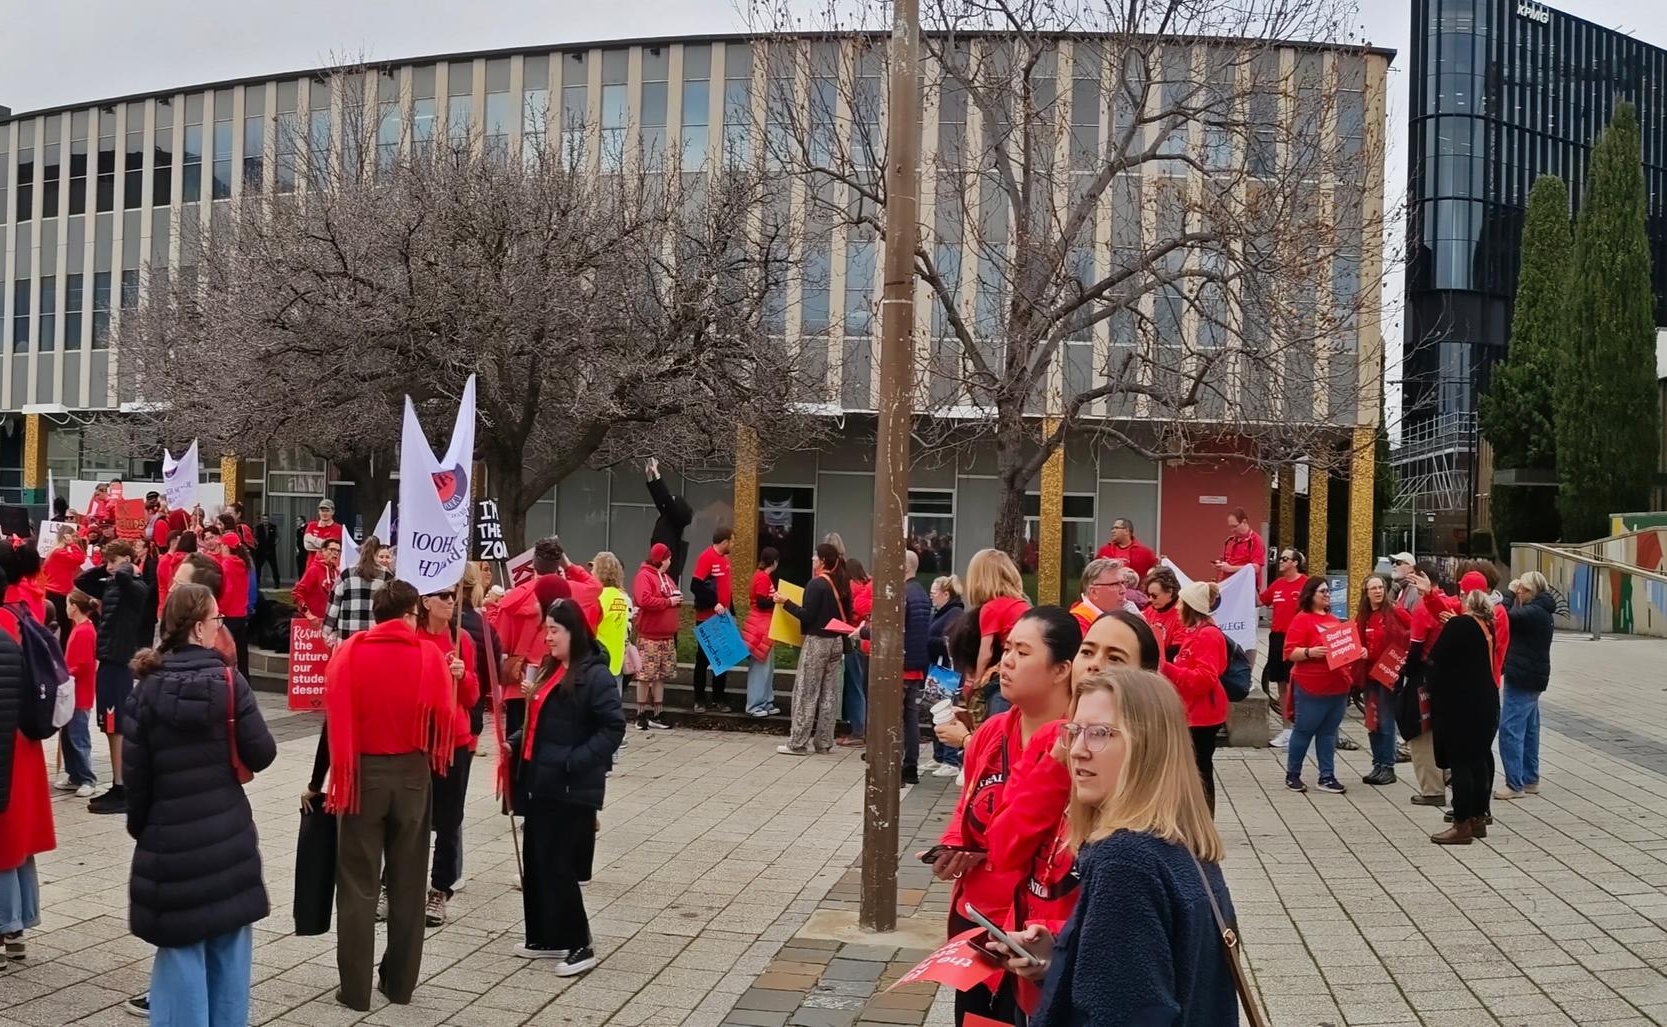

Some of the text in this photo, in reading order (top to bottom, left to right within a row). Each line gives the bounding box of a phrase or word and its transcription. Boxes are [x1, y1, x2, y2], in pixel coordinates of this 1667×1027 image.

[1517, 4, 1549, 24] KPMG
[477, 523, 503, 539] THE
[293, 625, 323, 641] Resour
[1326, 630, 1342, 642] Staff
[294, 641, 313, 651] the
[1330, 636, 1353, 649] schools
[1331, 642, 1356, 659] properly
[293, 652, 329, 662] future
[293, 665, 313, 673] our
[292, 674, 325, 684] stude
[292, 685, 326, 695] deser
